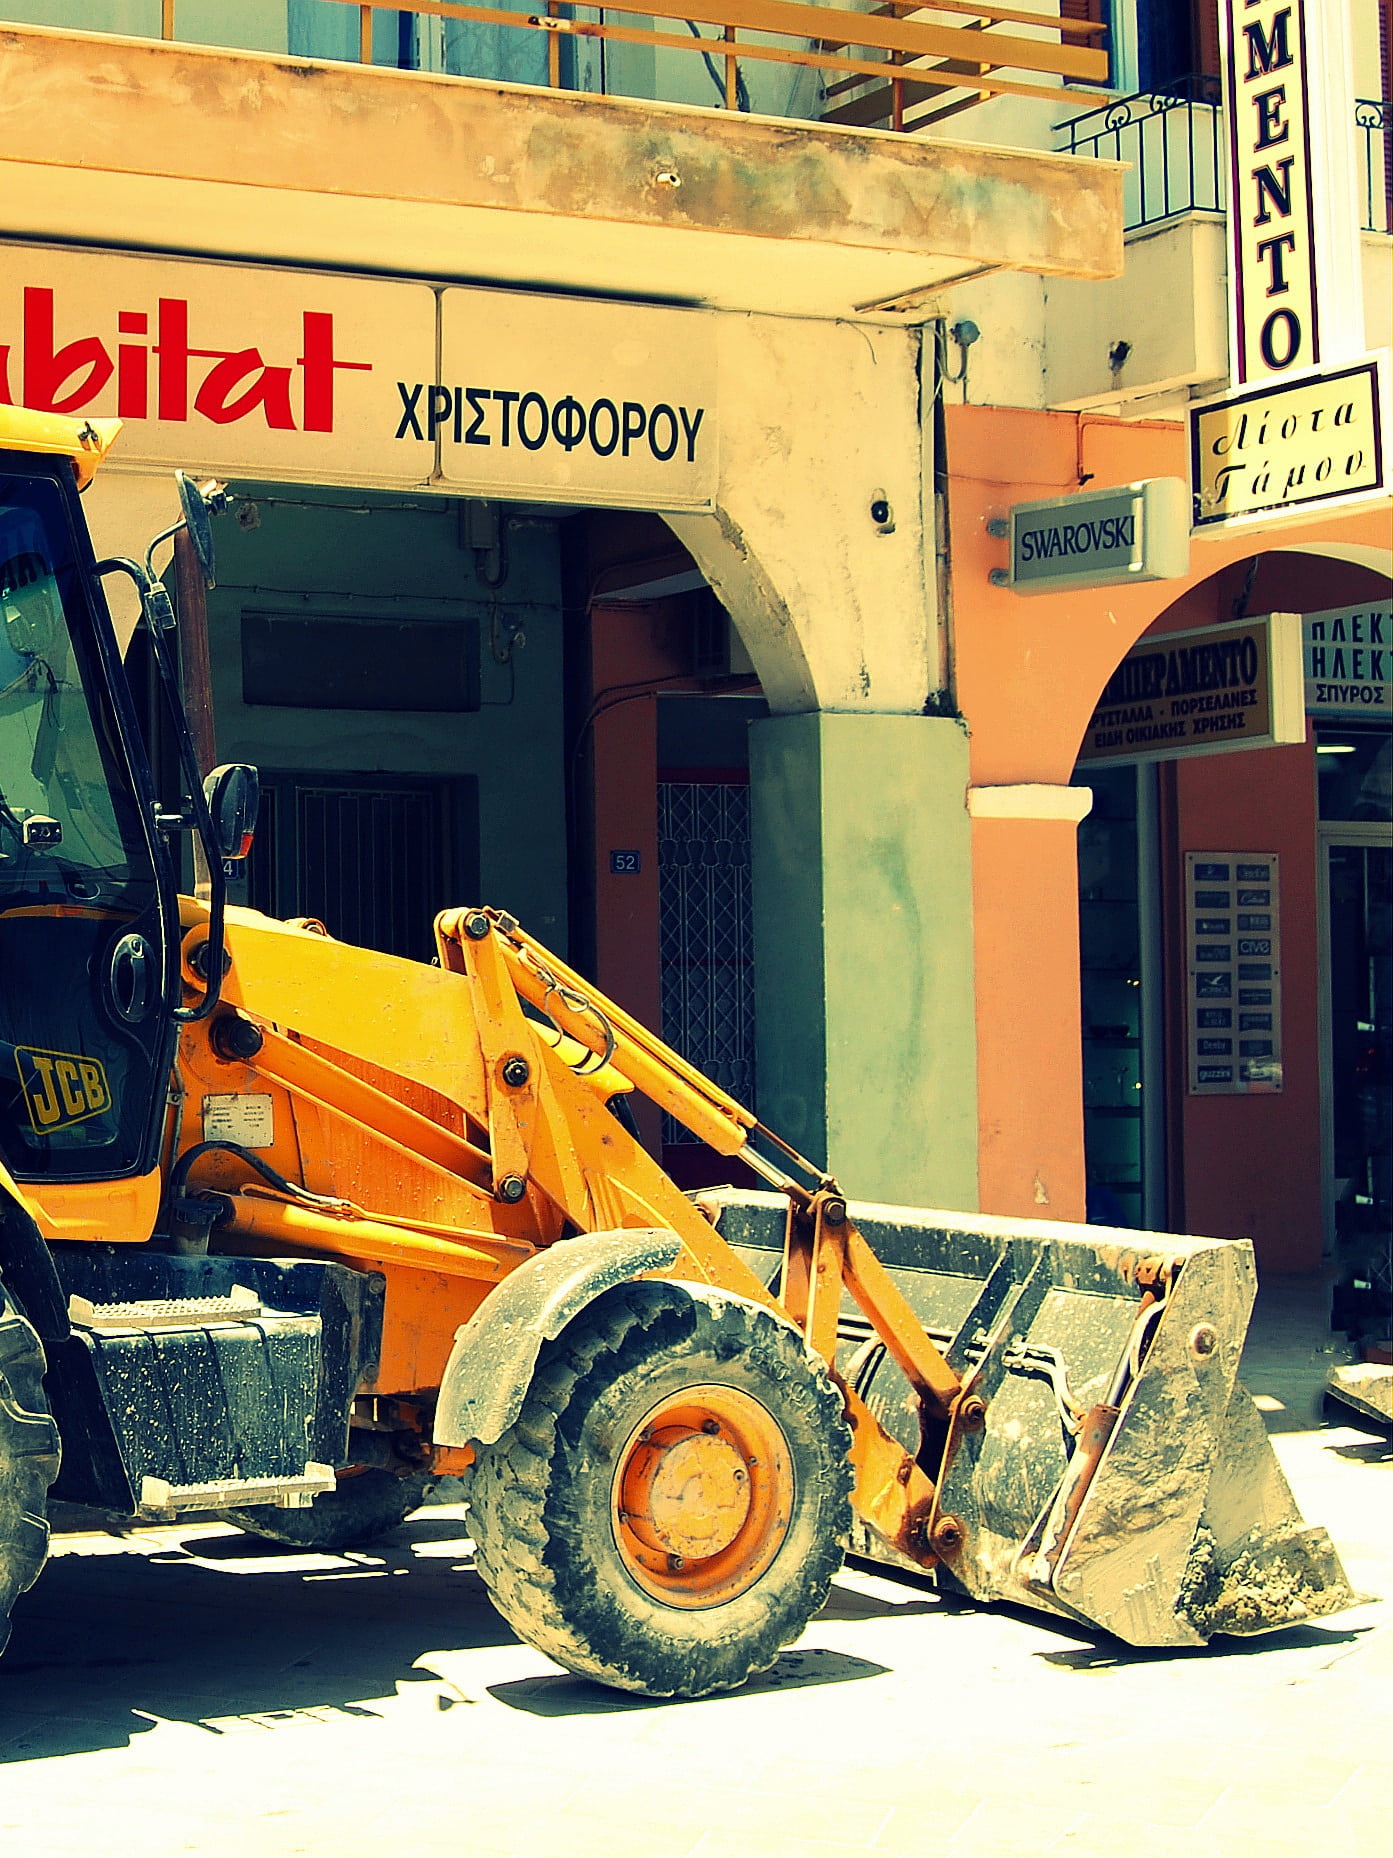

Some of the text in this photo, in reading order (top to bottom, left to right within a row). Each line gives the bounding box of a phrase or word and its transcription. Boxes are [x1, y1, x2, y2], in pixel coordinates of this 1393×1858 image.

[1242, 0, 1303, 370] ΜΕΝΤΟ
[395, 383, 705, 464] ΧΡΙΣΤΟΦΟΡΟΥ
[1212, 402, 1358, 456] Λίστα
[1021, 515, 1135, 562] SWAROVSKI
[1311, 612, 1392, 644] ΠΛΕΚ
[1312, 646, 1392, 681] ΗΛΕΚ
[1171, 689, 1258, 717] ΠΟΡΣΕΛΑΝΕΣ
[1316, 683, 1385, 704] ΣΠΥΡΟΣ
[1095, 711, 1246, 748] ΕΙΔΗ ΟΙΚΙΑΚΗΣ ΧΡΗΣΗΣ
[615, 855, 635, 870] 52
[32, 1056, 105, 1125] JCB
